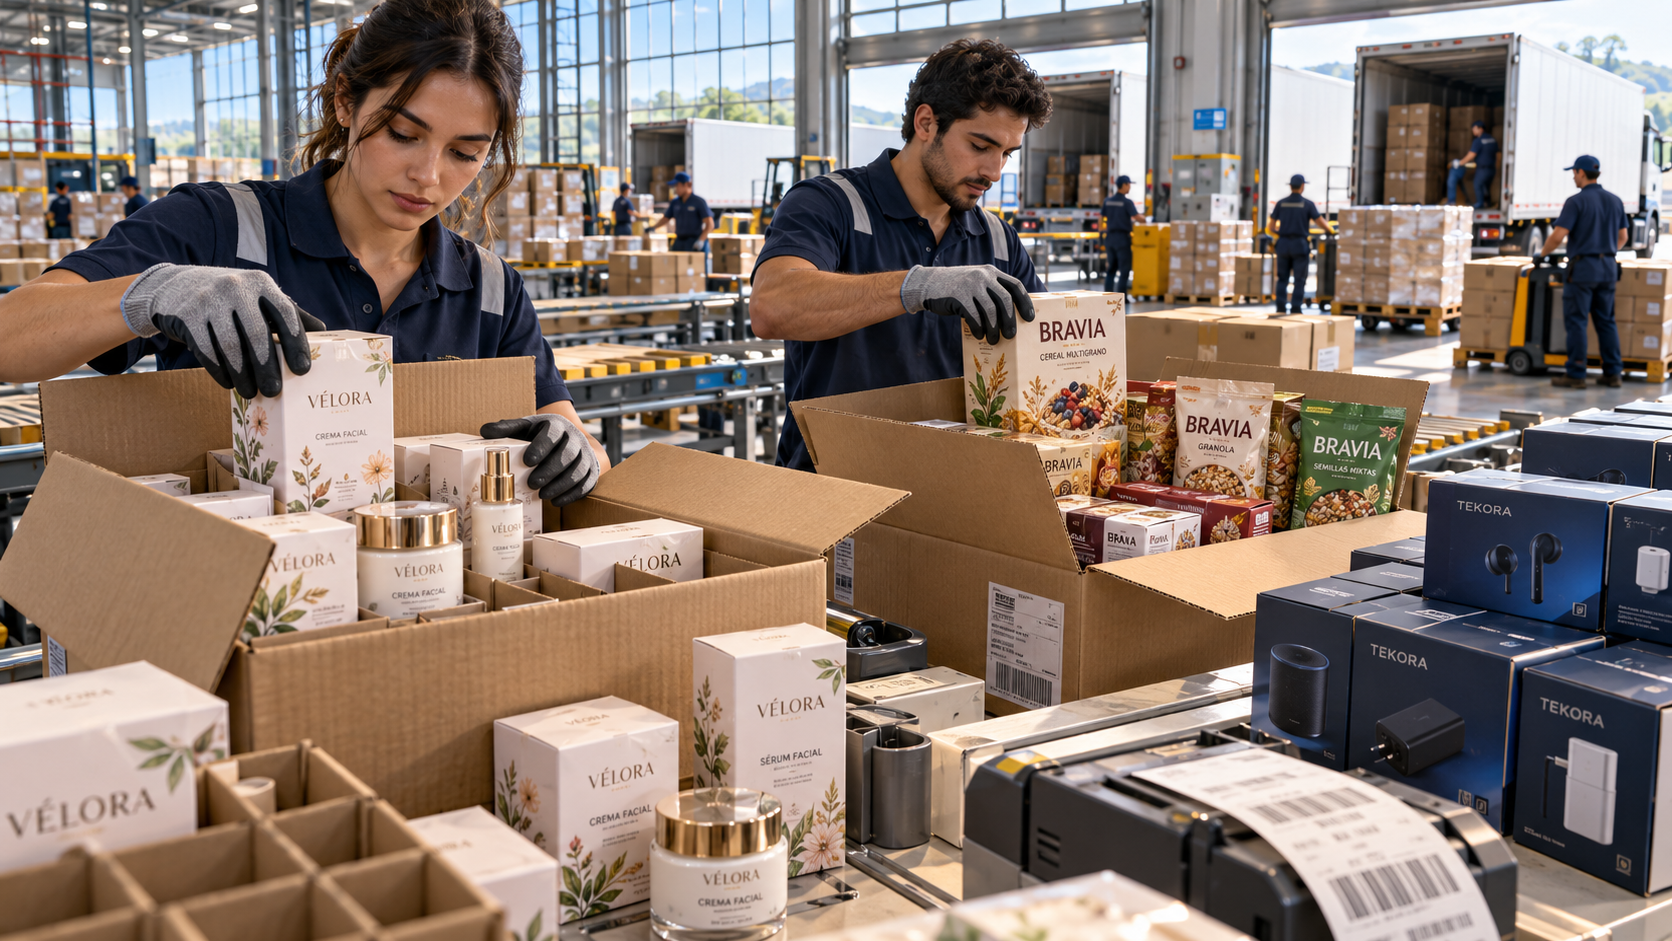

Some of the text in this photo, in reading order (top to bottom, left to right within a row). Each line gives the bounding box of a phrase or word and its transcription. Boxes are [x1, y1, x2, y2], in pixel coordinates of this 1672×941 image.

[1039, 318, 1106, 343] BRAVIA
[1039, 351, 1065, 362] CEREAL
[307, 390, 372, 409] VÉLORA
[315, 429, 368, 441] CREMA FACIAL
[1185, 415, 1253, 440] BRAVIA
[1198, 442, 1235, 454] GRANOLA
[1313, 435, 1382, 460] BRAVIA
[1045, 457, 1082, 473] BRAVIA
[1313, 462, 1349, 473] SEMILLAS
[1457, 500, 1512, 517] TEKORA
[269, 552, 336, 573] VÉLORA
[394, 563, 444, 578] VÉLORA
[623, 552, 682, 571] ÉLORA
[392, 591, 420, 600] CREMA
[1370, 643, 1428, 671] TEKORA
[757, 695, 825, 718] VÉLORA
[1540, 696, 1605, 729] TEKORA
[760, 748, 823, 766] SÉRUM FACIAL
[588, 762, 655, 790] VÉLORA
[6, 787, 156, 838] VÉLORA
[589, 804, 652, 827] CREMA FACIAL
[702, 869, 760, 886] VÉLORA
[697, 892, 763, 908] CREMA FACIAL
